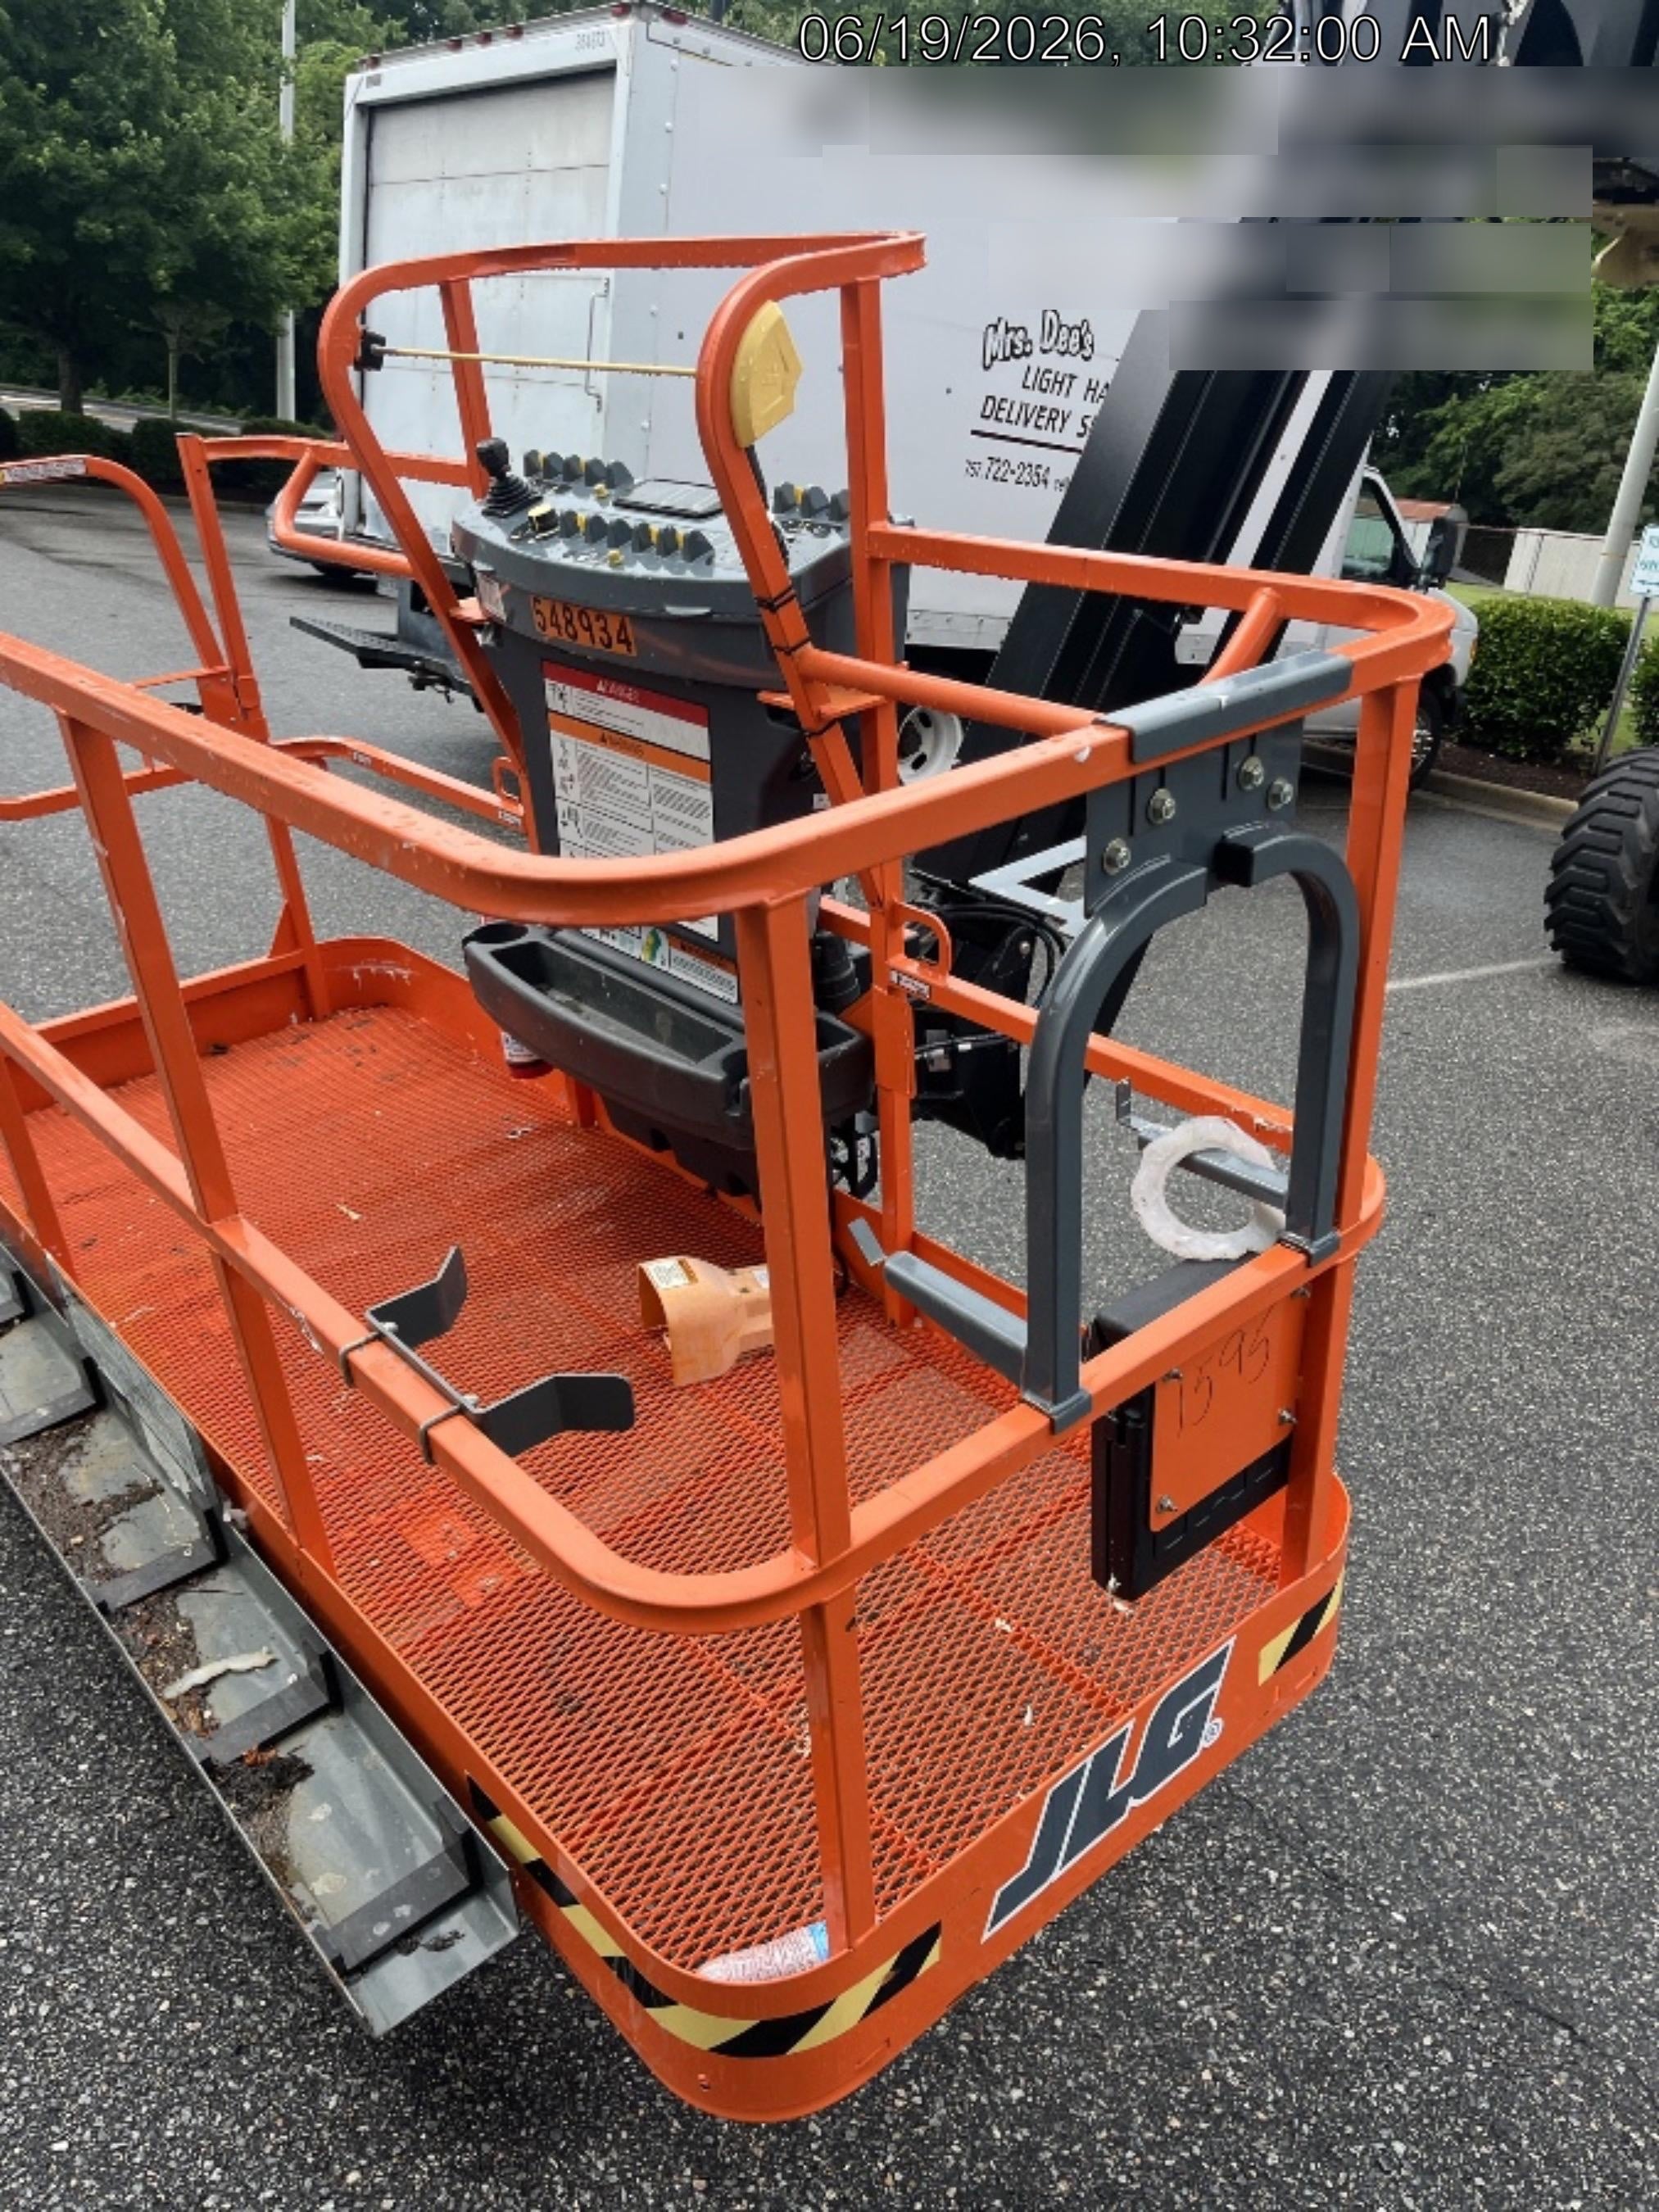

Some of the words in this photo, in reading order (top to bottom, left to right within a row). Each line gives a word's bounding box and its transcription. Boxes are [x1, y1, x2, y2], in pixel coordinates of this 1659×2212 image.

[983, 317, 1032, 370] Mrs.
[1022, 365, 1077, 398] LIGHT
[980, 395, 1072, 434] DELIVERY
[984, 456, 1050, 490] 722-2354
[532, 596, 633, 655] 548934
[981, 1634, 1236, 1943] JLG
